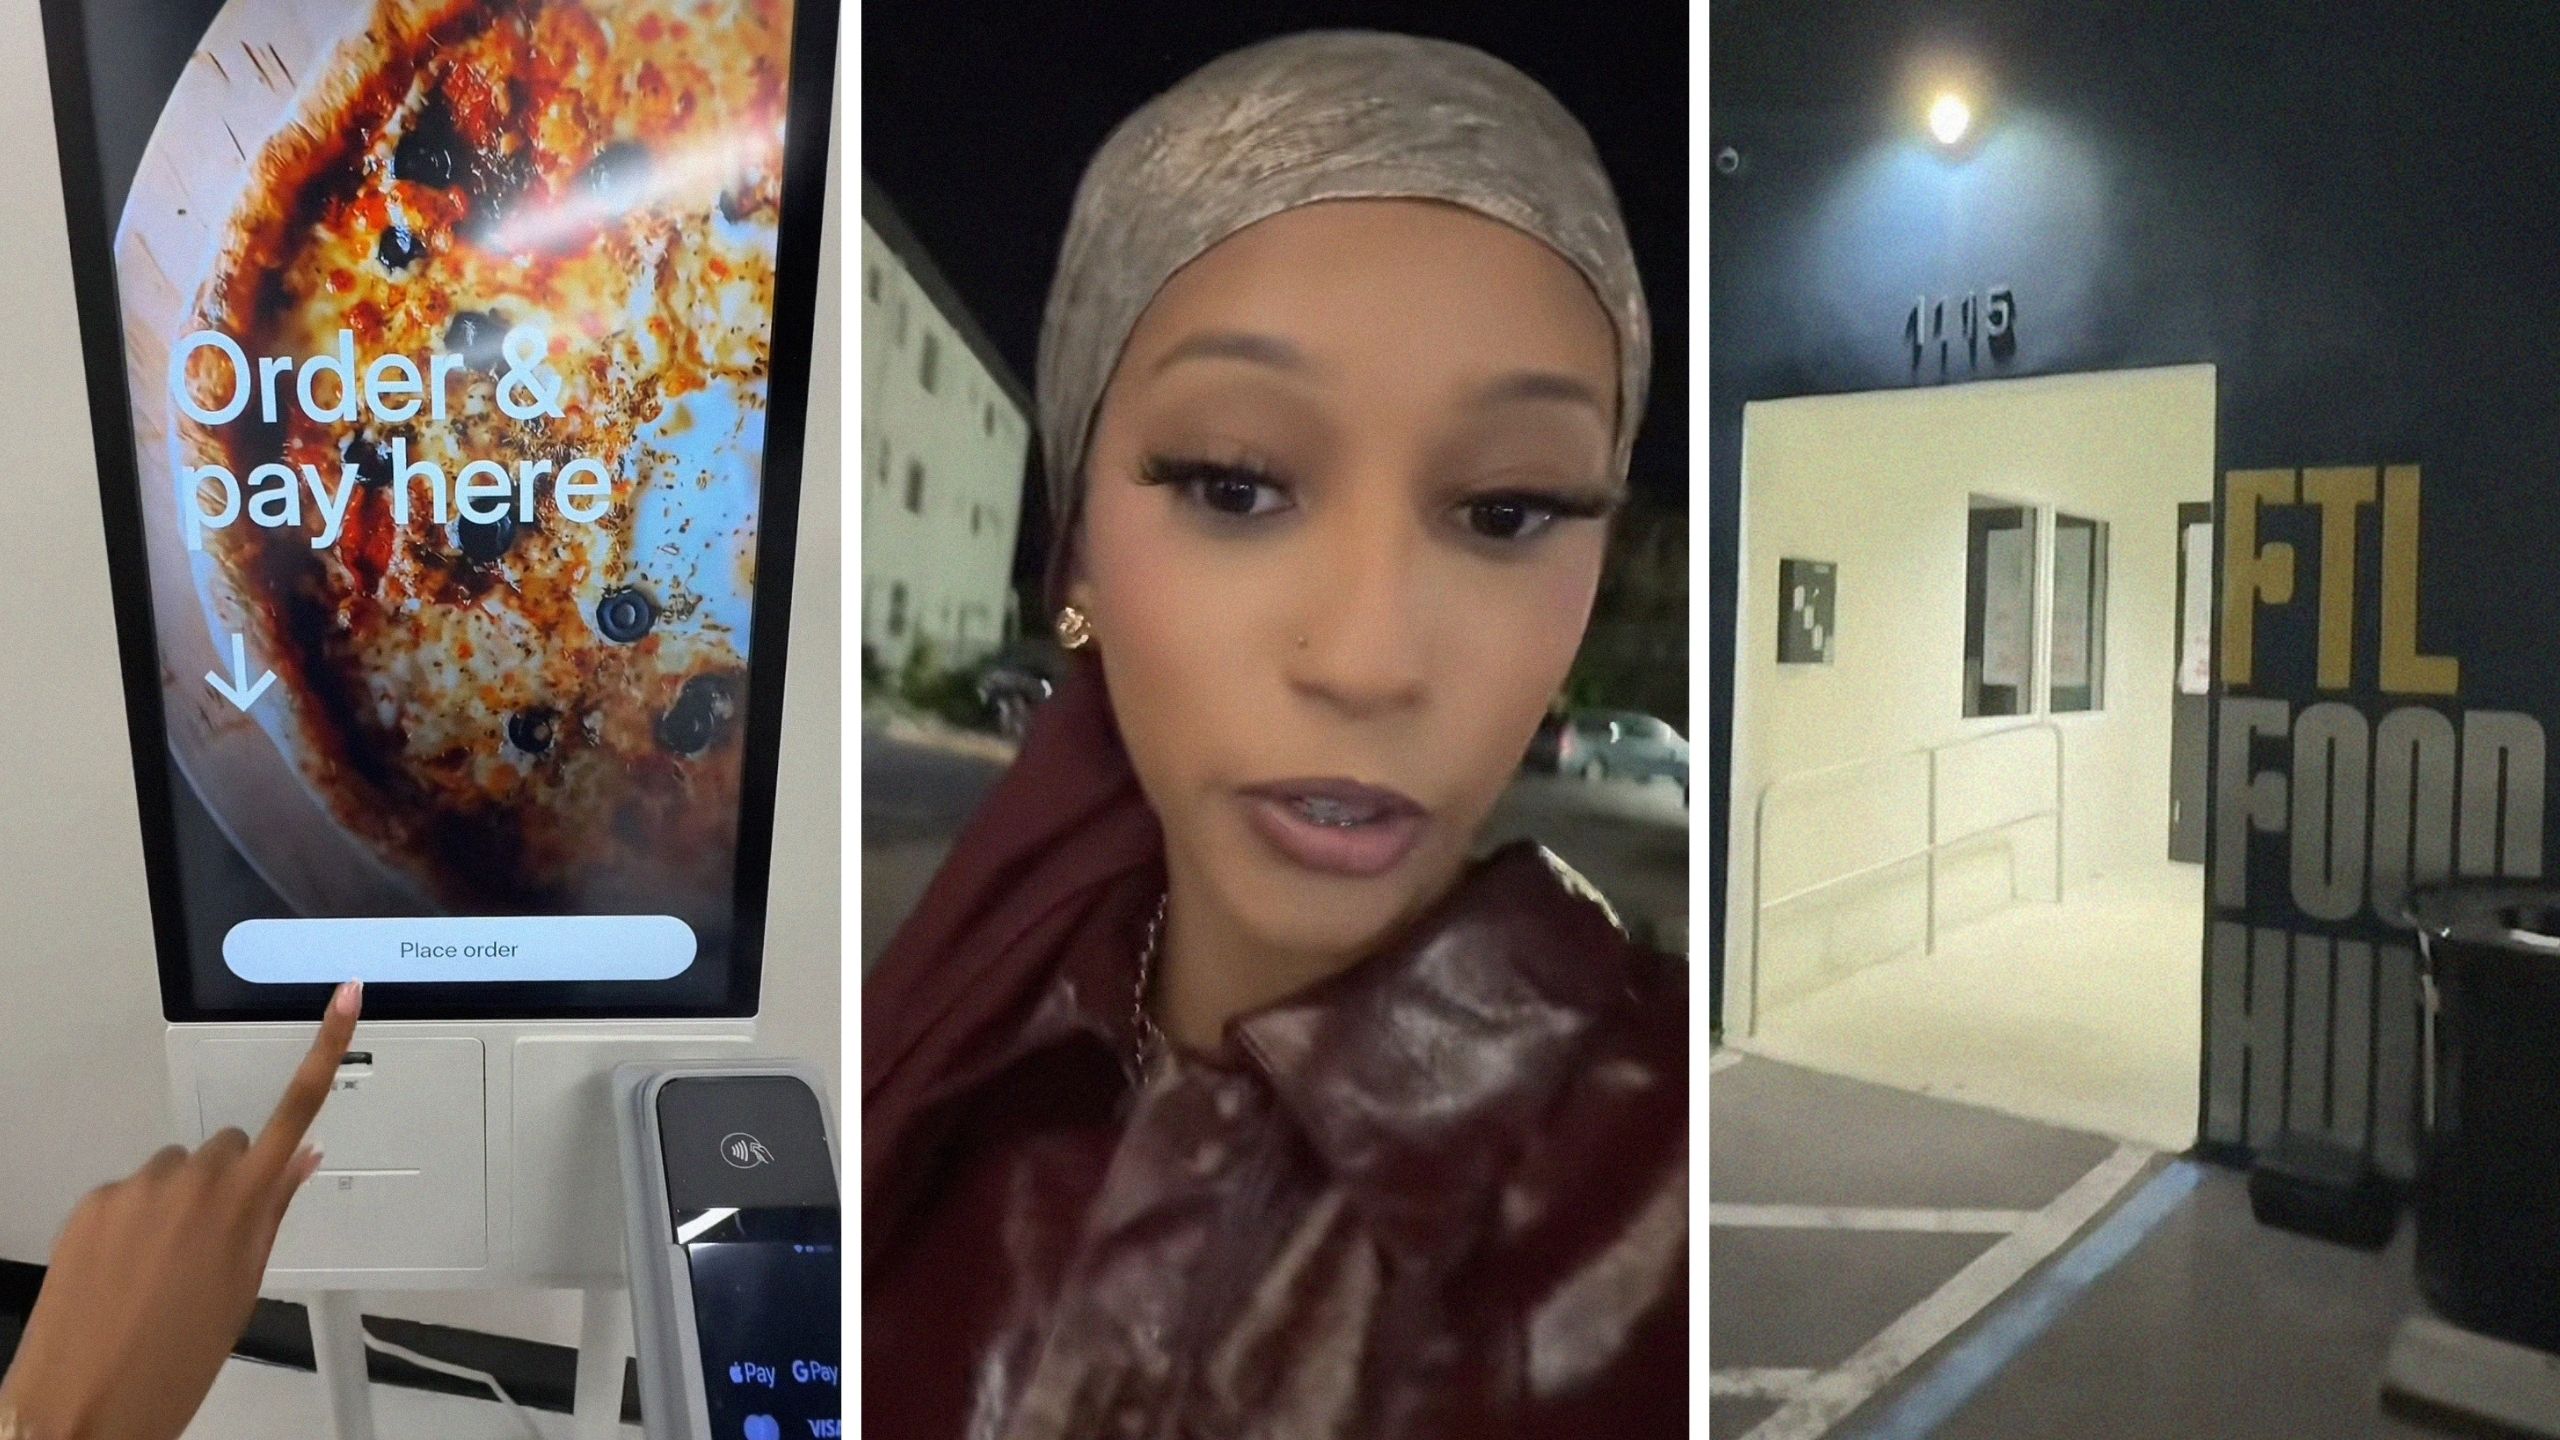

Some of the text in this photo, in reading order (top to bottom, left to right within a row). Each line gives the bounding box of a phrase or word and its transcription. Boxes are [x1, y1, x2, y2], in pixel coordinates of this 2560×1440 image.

[1905, 286, 2014, 352] 1115
[170, 328, 564, 426] Order &
[182, 436, 613, 551] pay here
[2219, 464, 2460, 696] FTL
[2213, 698, 2547, 932] FOOD
[400, 940, 519, 959] Place order
[743, 1361, 776, 1389] Pay
